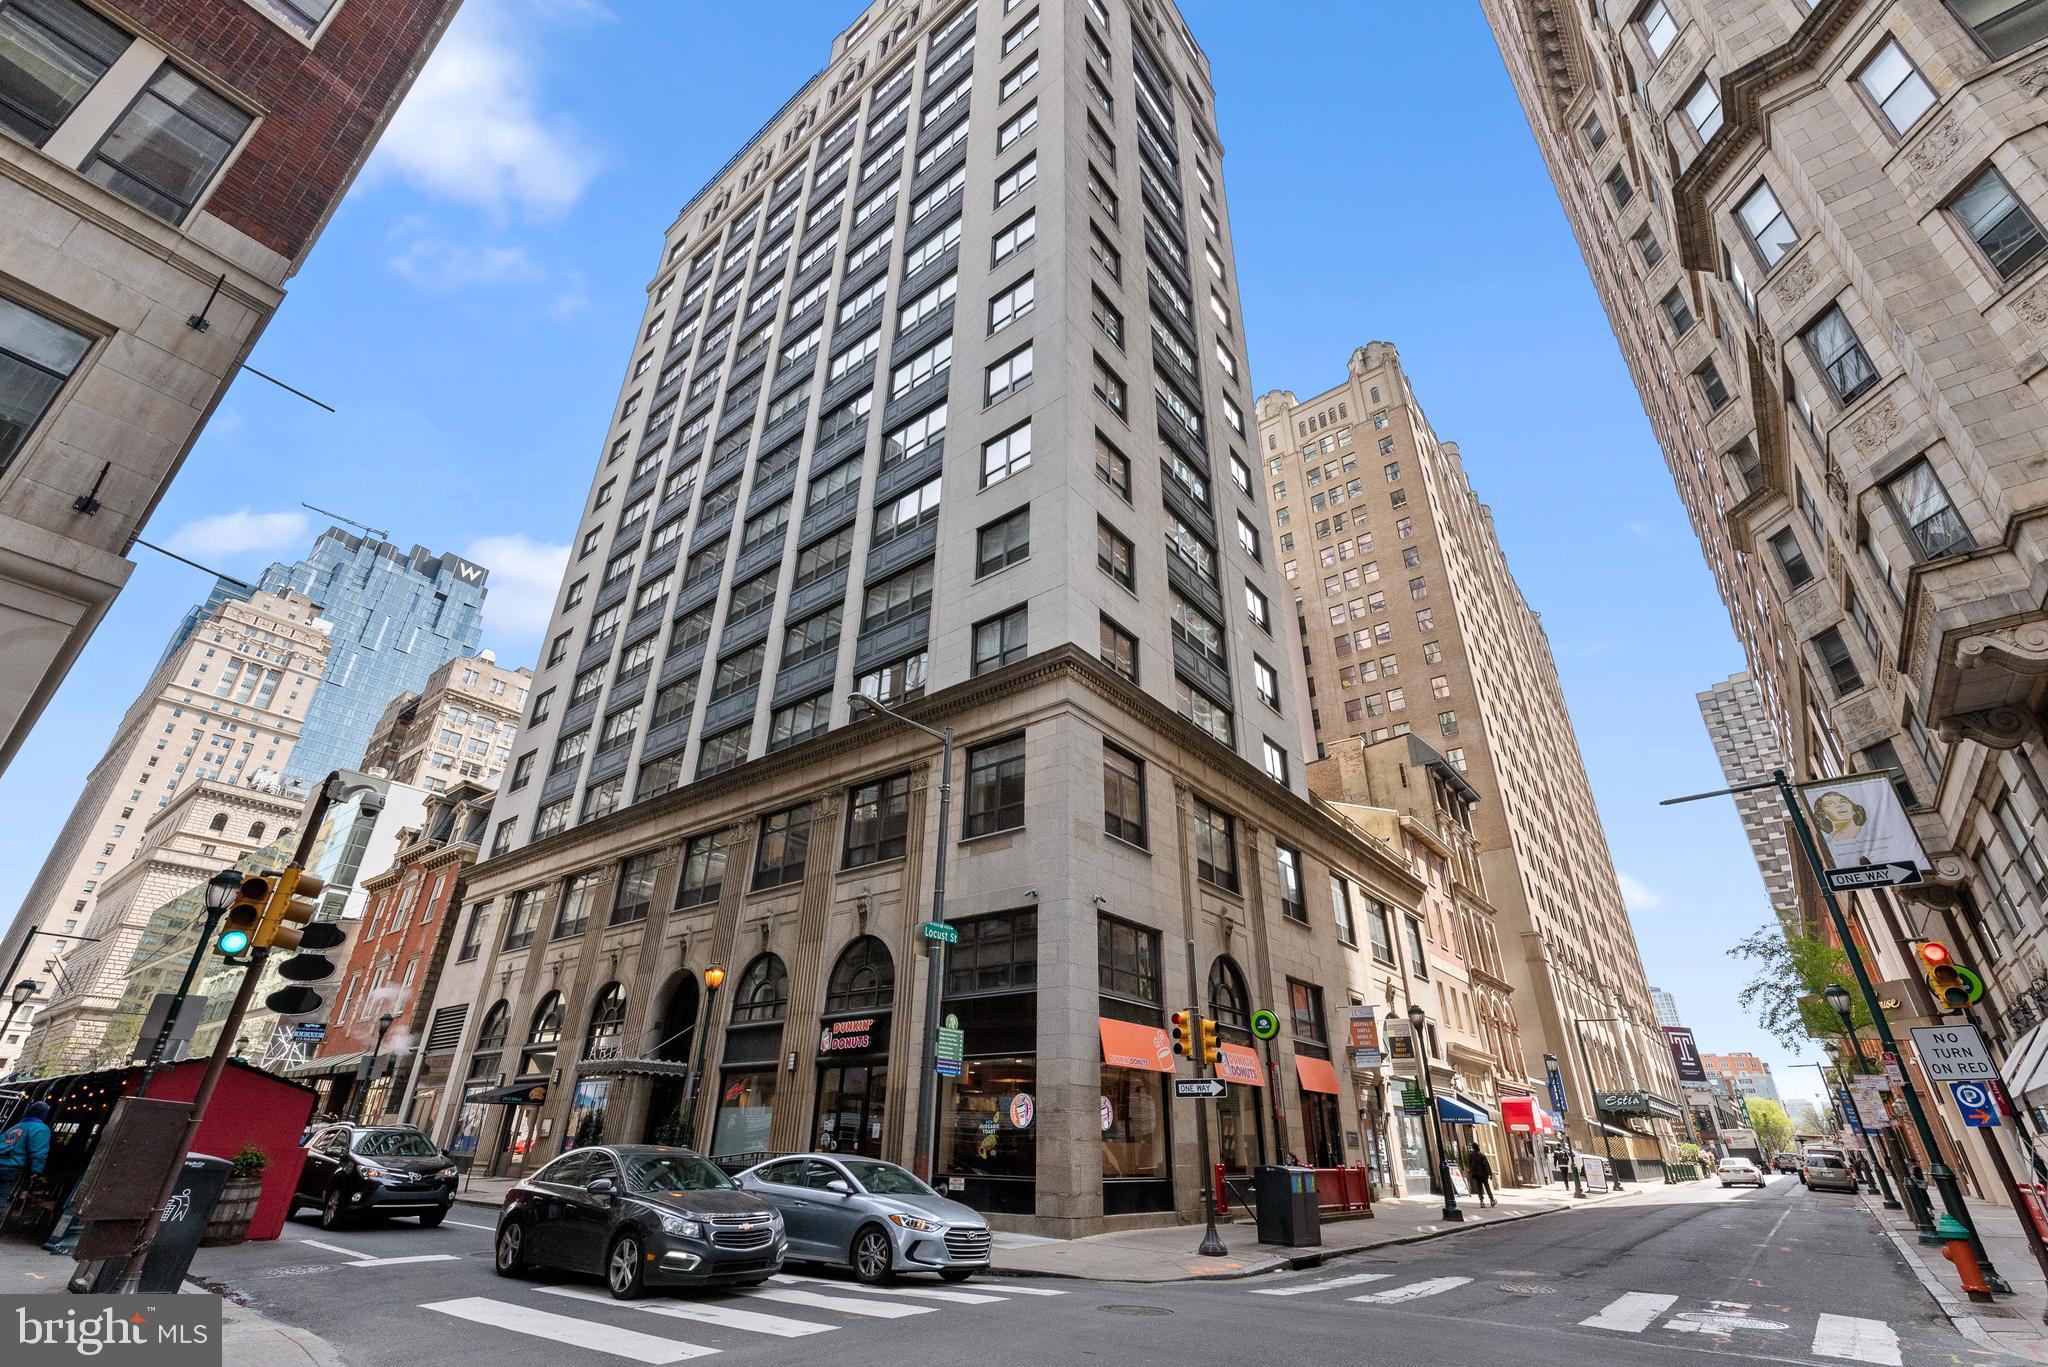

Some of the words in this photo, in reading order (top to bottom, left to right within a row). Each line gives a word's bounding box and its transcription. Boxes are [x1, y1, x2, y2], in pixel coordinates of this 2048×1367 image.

[460, 562, 482, 581] W
[1836, 874, 1863, 885] ONE
[1865, 870, 1889, 881] WAY
[924, 926, 949, 941] Locust
[950, 933, 958, 943] St
[832, 1019, 873, 1034] DUNKIN'
[831, 1035, 870, 1050] DONUTS
[1932, 1032, 1958, 1043] NO
[588, 1043, 623, 1060] ARIA
[1932, 1047, 1973, 1058] TURN
[1230, 1065, 1258, 1080] DONUTS
[1932, 1063, 1953, 1074] ON
[1957, 1062, 1989, 1073] RED
[1180, 1084, 1195, 1093] ONE
[1196, 1084, 1211, 1093] WAY
[1605, 1095, 1640, 1106] Estia
